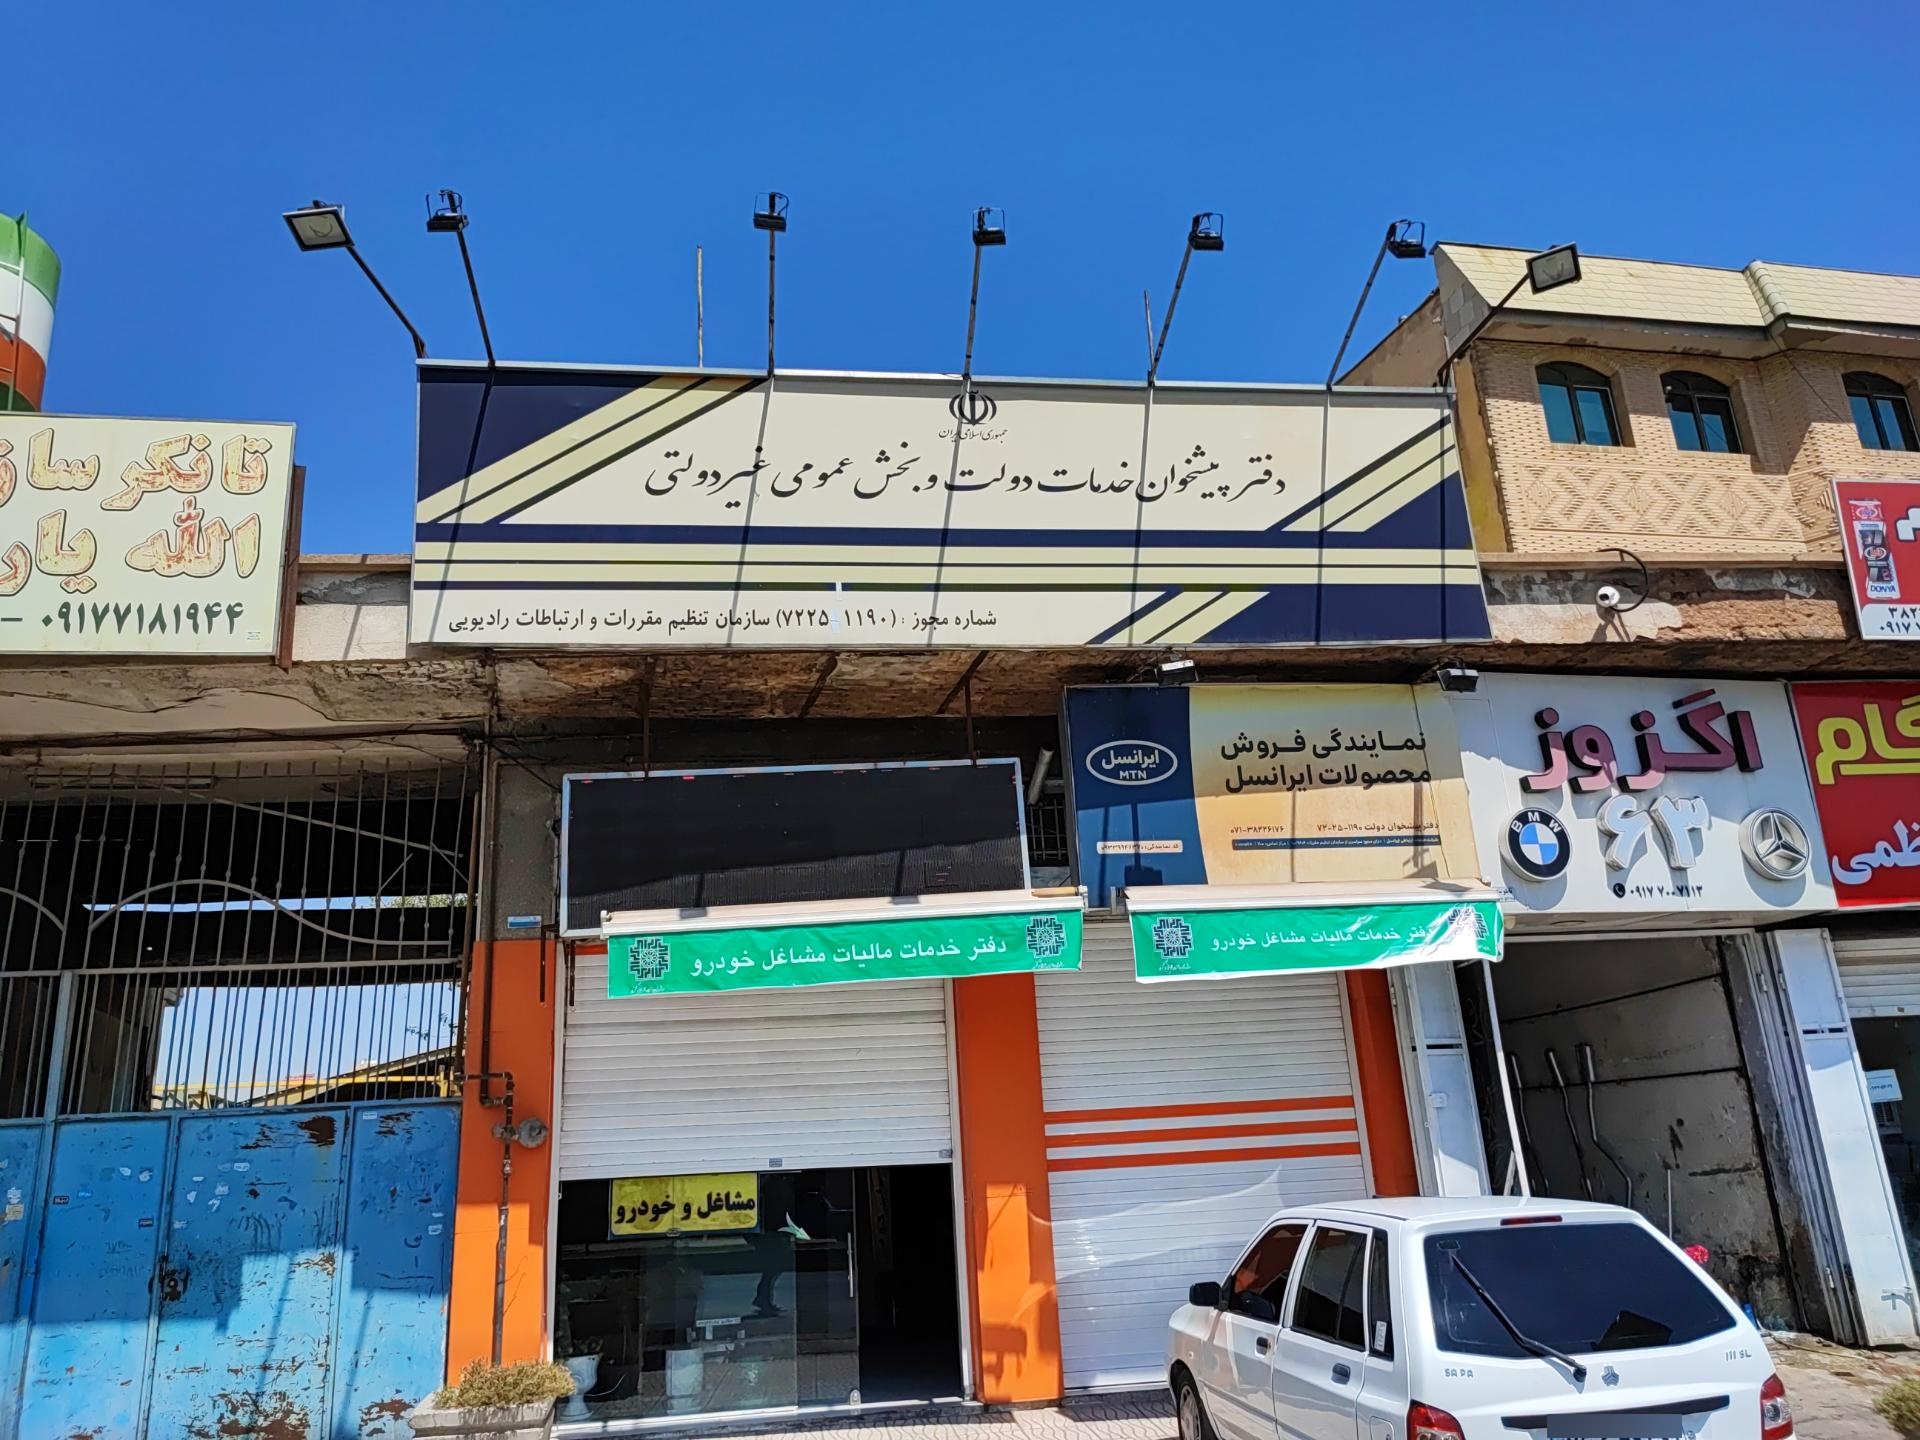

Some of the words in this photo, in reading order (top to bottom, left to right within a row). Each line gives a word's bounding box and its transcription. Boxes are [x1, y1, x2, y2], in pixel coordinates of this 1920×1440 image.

[100, 433, 272, 511] تانکر
[770, 457, 854, 498] عمومی
[853, 440, 921, 500] بخش
[921, 473, 938, 491] و
[943, 463, 1033, 492] دولت
[1037, 461, 1135, 493] خدمات
[1135, 444, 1230, 502] پیشخوان
[1226, 453, 1287, 503] دفتر
[124, 495, 261, 579] الله
[1870, 584, 1897, 594] DONYA
[41, 601, 245, 635] ۰۹۱۷۷۱۸۱۹۴۴
[448, 608, 510, 633] رادیویی
[516, 608, 584, 632] ارتباطات
[589, 614, 598, 631] و
[603, 608, 663, 632] مقررات
[668, 608, 709, 636] تنظیم
[715, 608, 770, 631] سازمان
[954, 610, 997, 631] شماره
[1220, 728, 1307, 760] فروش
[1312, 728, 1427, 759] نمایندگی
[1518, 688, 1765, 794] اگزوز
[1101, 749, 1160, 770] ایرانسل
[1118, 769, 1148, 781] MTN
[1225, 763, 1313, 794] ایرانسل
[1318, 763, 1433, 790] محصولات
[1364, 822, 1386, 833] دولت
[1510, 811, 1562, 833] BMW
[1597, 794, 1711, 871] ۶۳
[1210, 933, 1257, 952] خودرو
[1261, 930, 1306, 949] مشاغل
[1310, 928, 1352, 947] مالیات
[1357, 926, 1400, 941] خدمات
[762, 944, 826, 971] مشاغل
[832, 941, 893, 968] مالیات
[899, 938, 961, 959] خدمات
[967, 935, 1007, 961] دفتر
[689, 949, 755, 977] خودرو
[613, 1194, 676, 1224] خودرو
[680, 1201, 692, 1222] و
[696, 1190, 756, 1219] مشاغل
